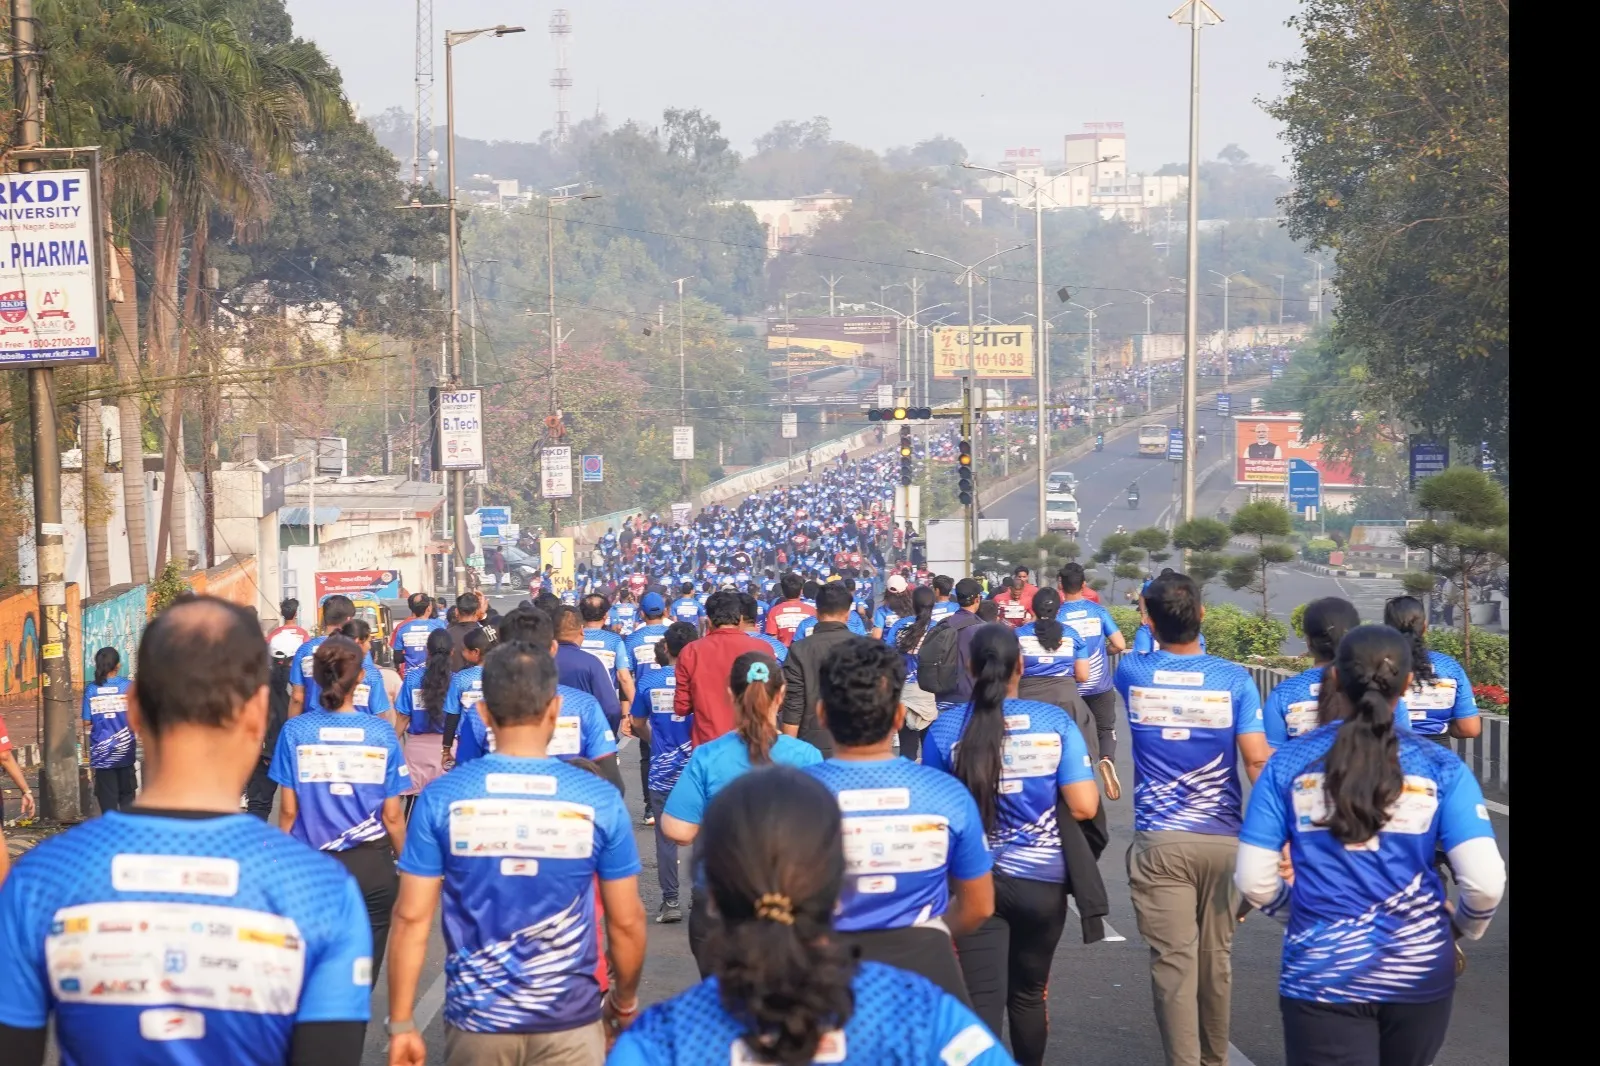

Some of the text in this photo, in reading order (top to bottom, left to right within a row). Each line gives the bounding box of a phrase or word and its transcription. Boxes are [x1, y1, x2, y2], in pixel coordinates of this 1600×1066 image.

[11, 240, 89, 268] PHARMA
[28, 337, 91, 348] 1800-2700-320
[31, 350, 90, 359] www.rkdf.ac.in
[1009, 353, 1024, 366] 38
[441, 393, 476, 403] RKDF
[443, 418, 478, 430] B.Tech
[542, 448, 569, 456] RKDF
